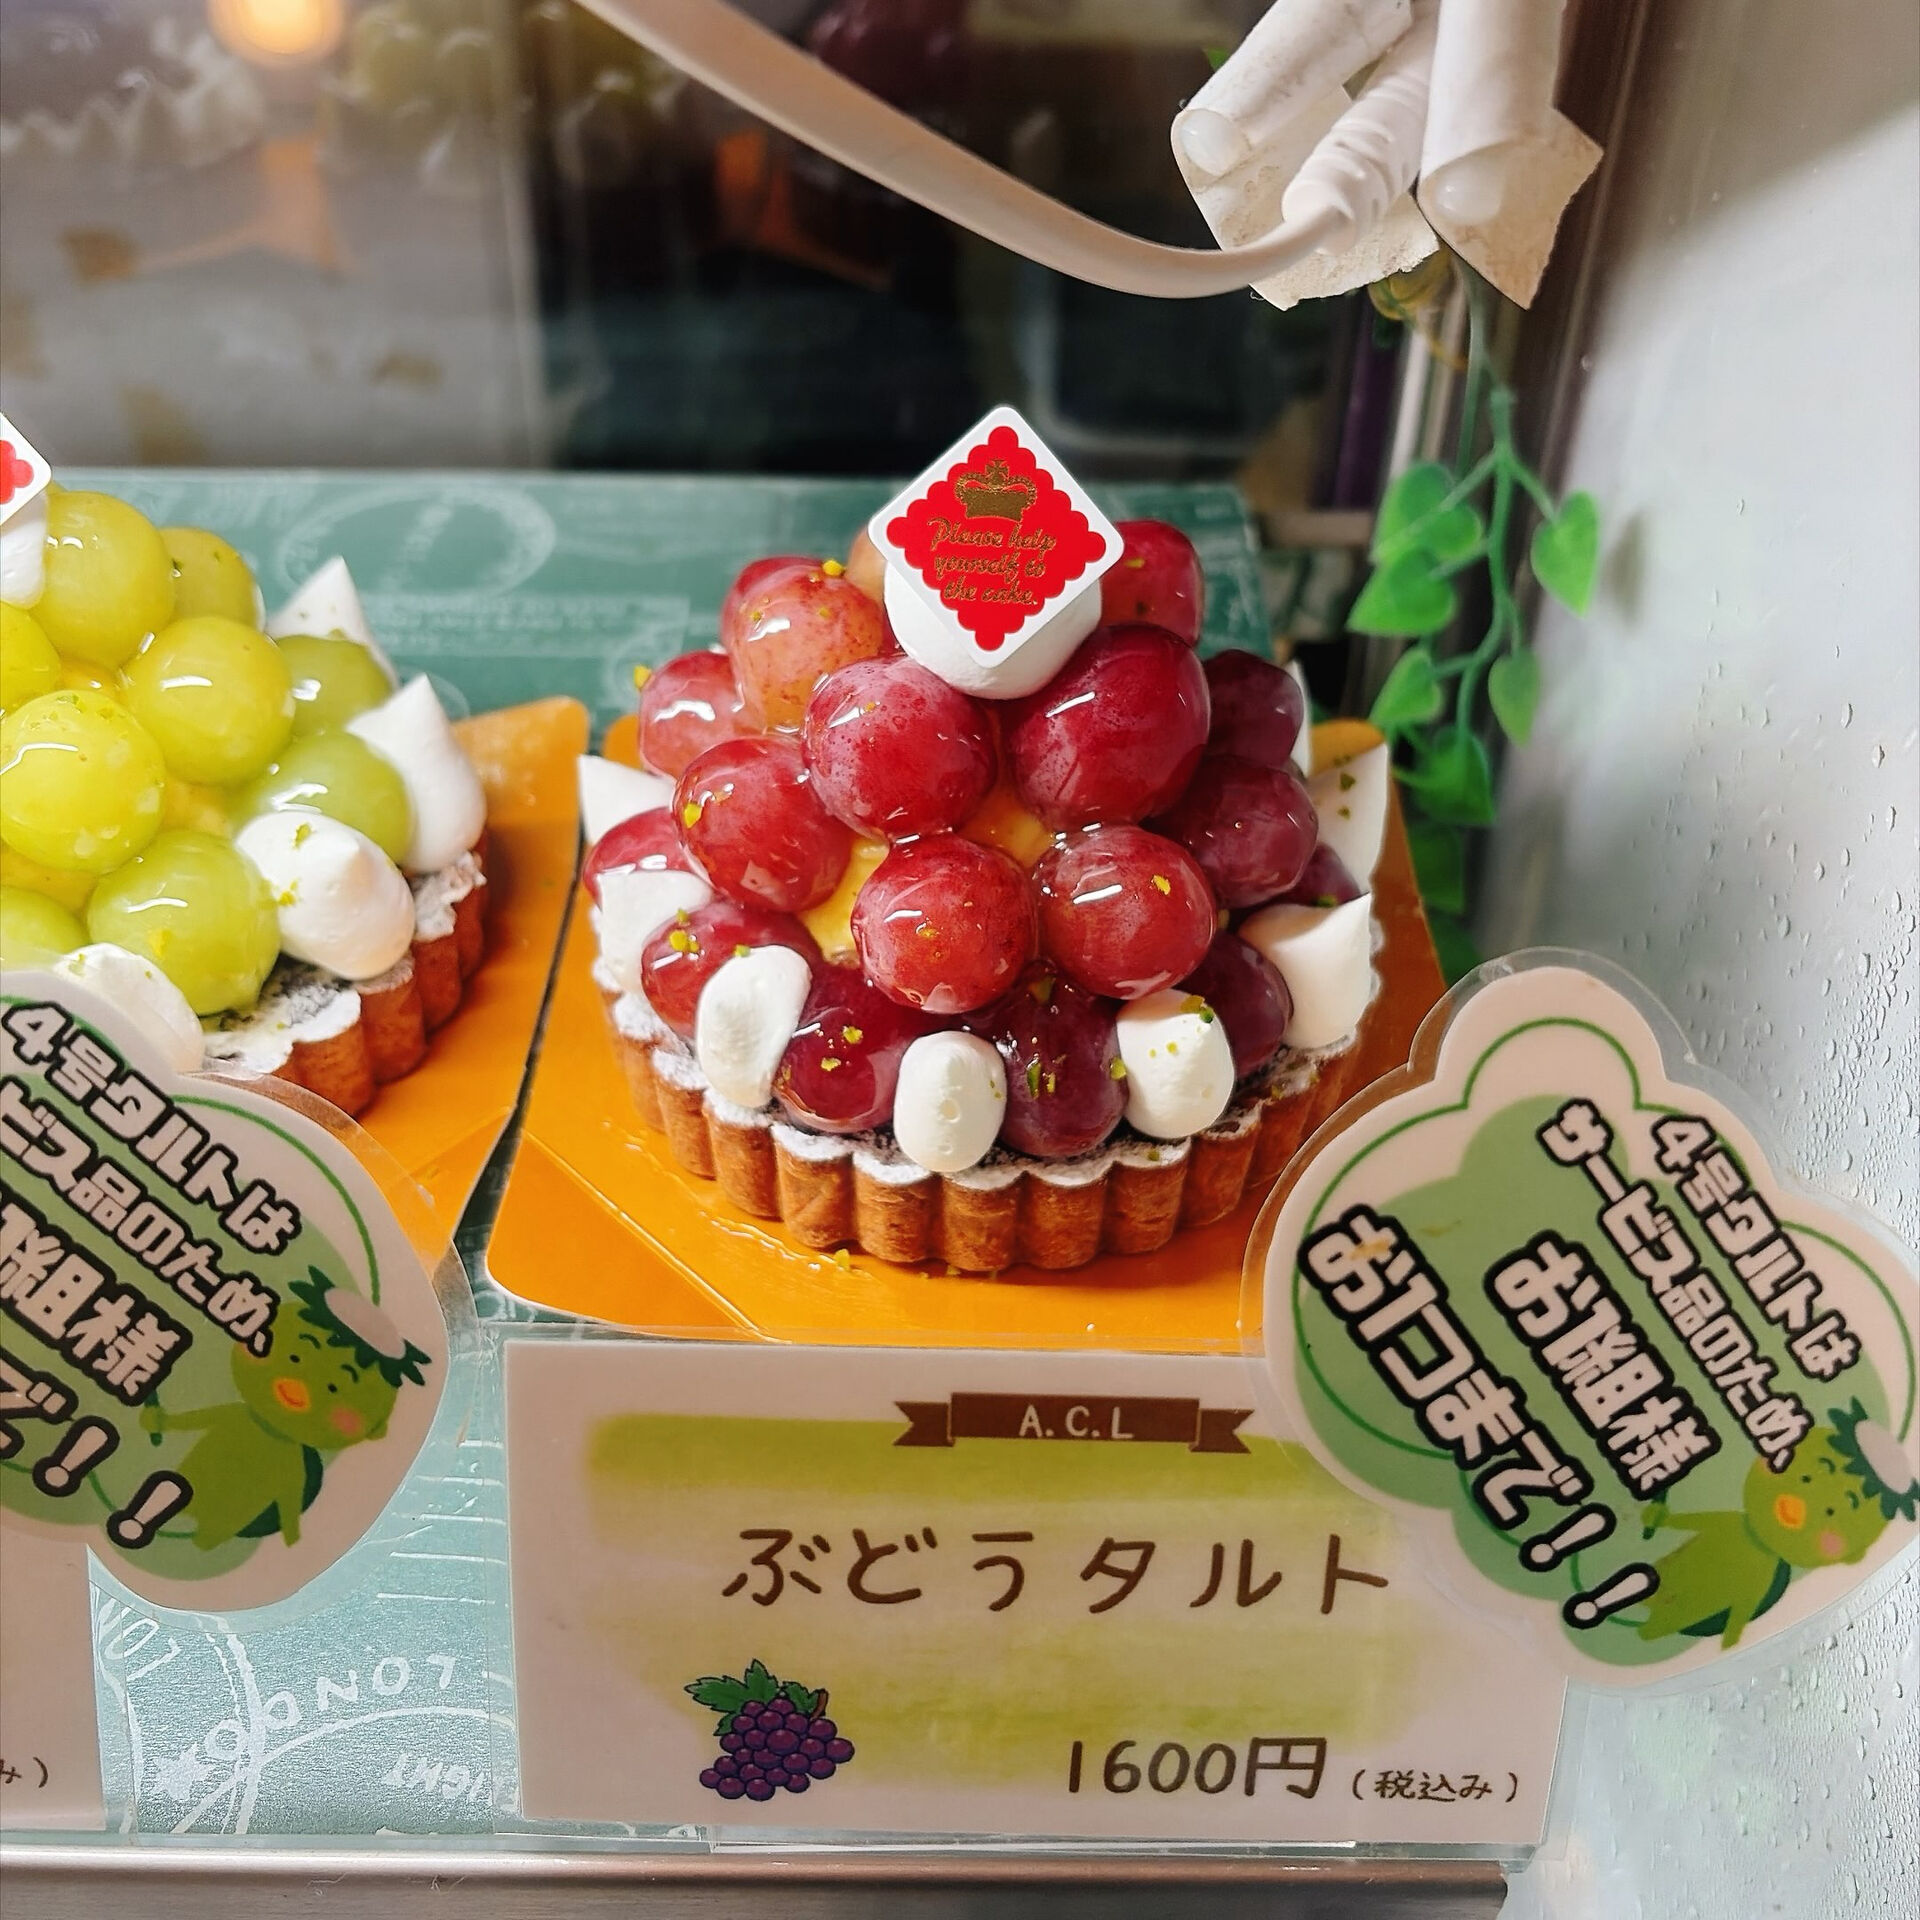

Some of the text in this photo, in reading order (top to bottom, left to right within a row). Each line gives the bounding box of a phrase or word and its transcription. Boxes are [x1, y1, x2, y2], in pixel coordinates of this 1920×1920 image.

[927, 517, 1057, 559] Please help
[933, 552, 1046, 583] yourself to
[943, 576, 1038, 605] the cake.
[1, 1001, 303, 1255] 4号タルトは
[1651, 1112, 1864, 1384] 4号タルトは
[1483, 1229, 1722, 1501] お1組様
[1019, 1404, 1135, 1440] A.C.L
[722, 1527, 1389, 1614] ぶどうタルト
[1068, 1737, 1328, 1799] 1600円
